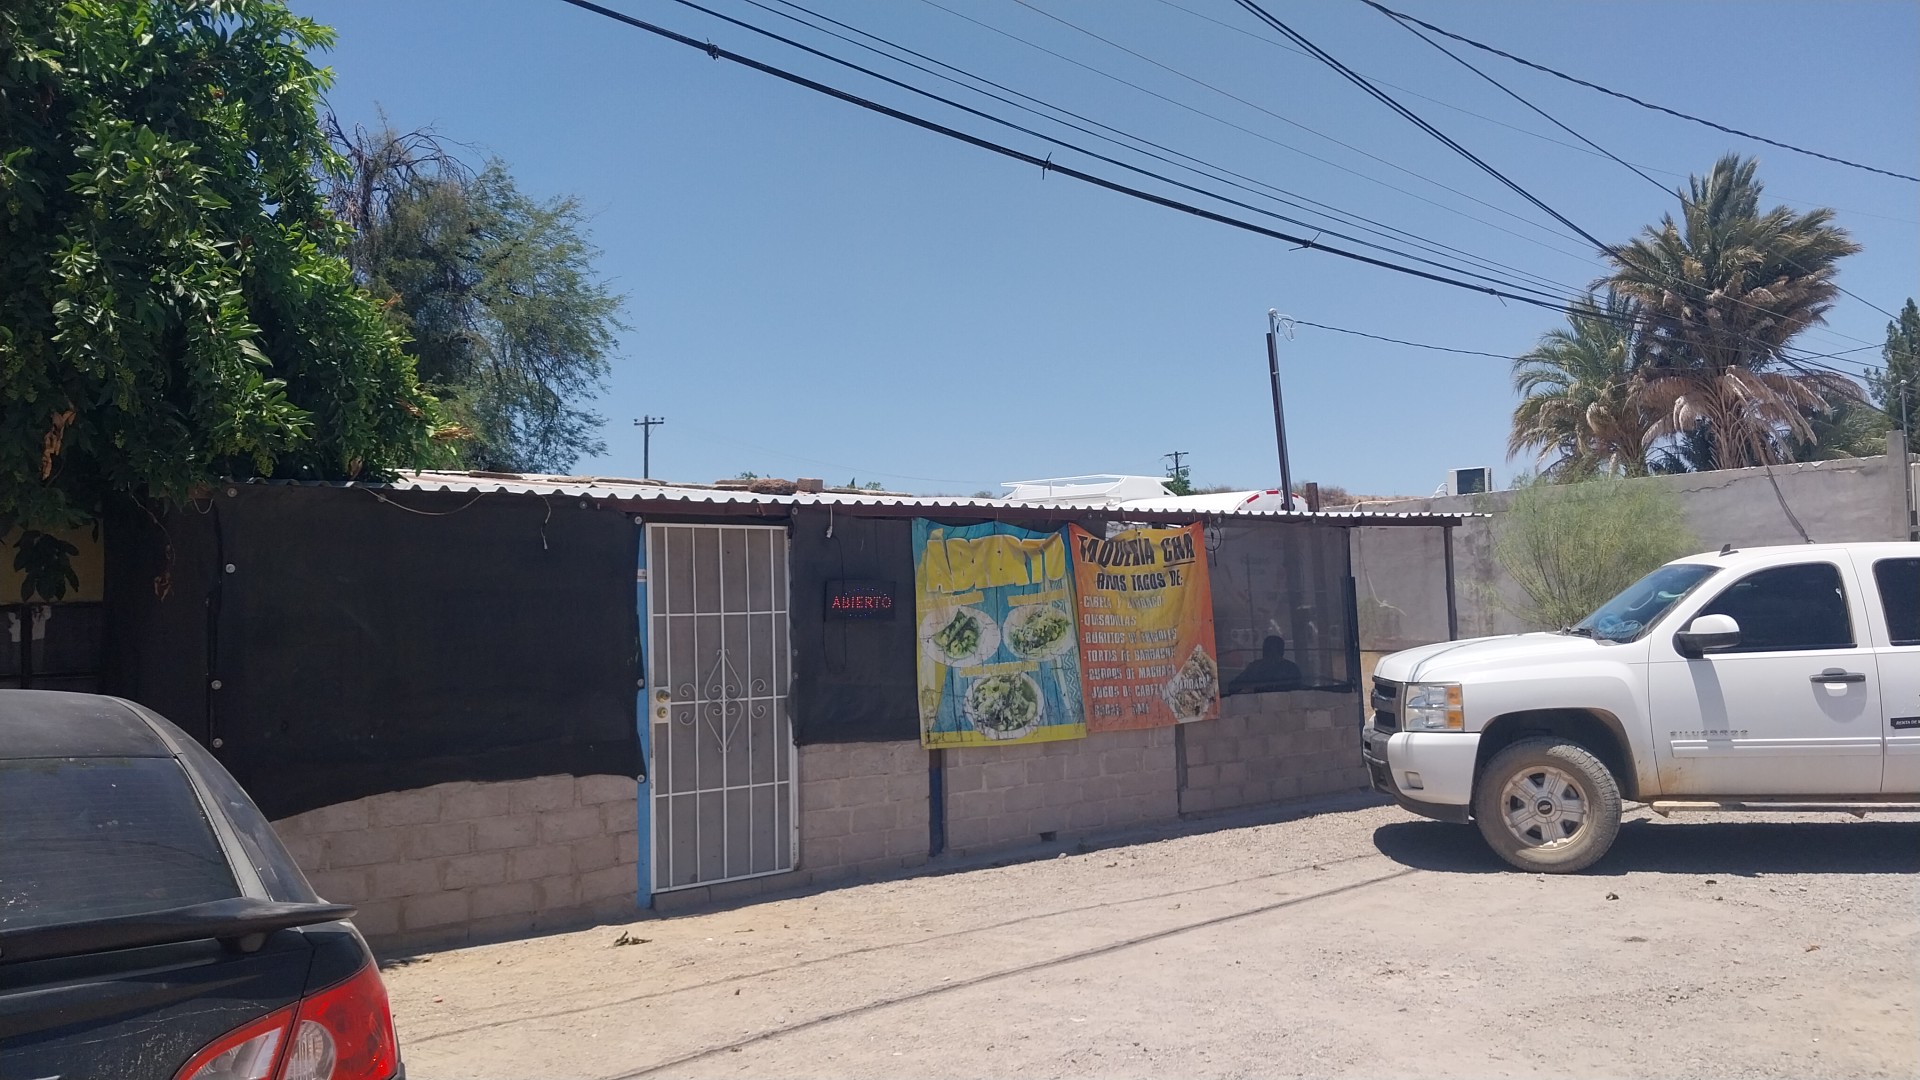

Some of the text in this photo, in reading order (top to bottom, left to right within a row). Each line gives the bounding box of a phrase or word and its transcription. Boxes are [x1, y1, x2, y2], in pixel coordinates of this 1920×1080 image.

[1130, 572, 1166, 592] TACOS
[831, 596, 892, 608] ABIERTO
[1085, 631, 1125, 643] BURRITOS
[1087, 649, 1117, 662] TORTAS
